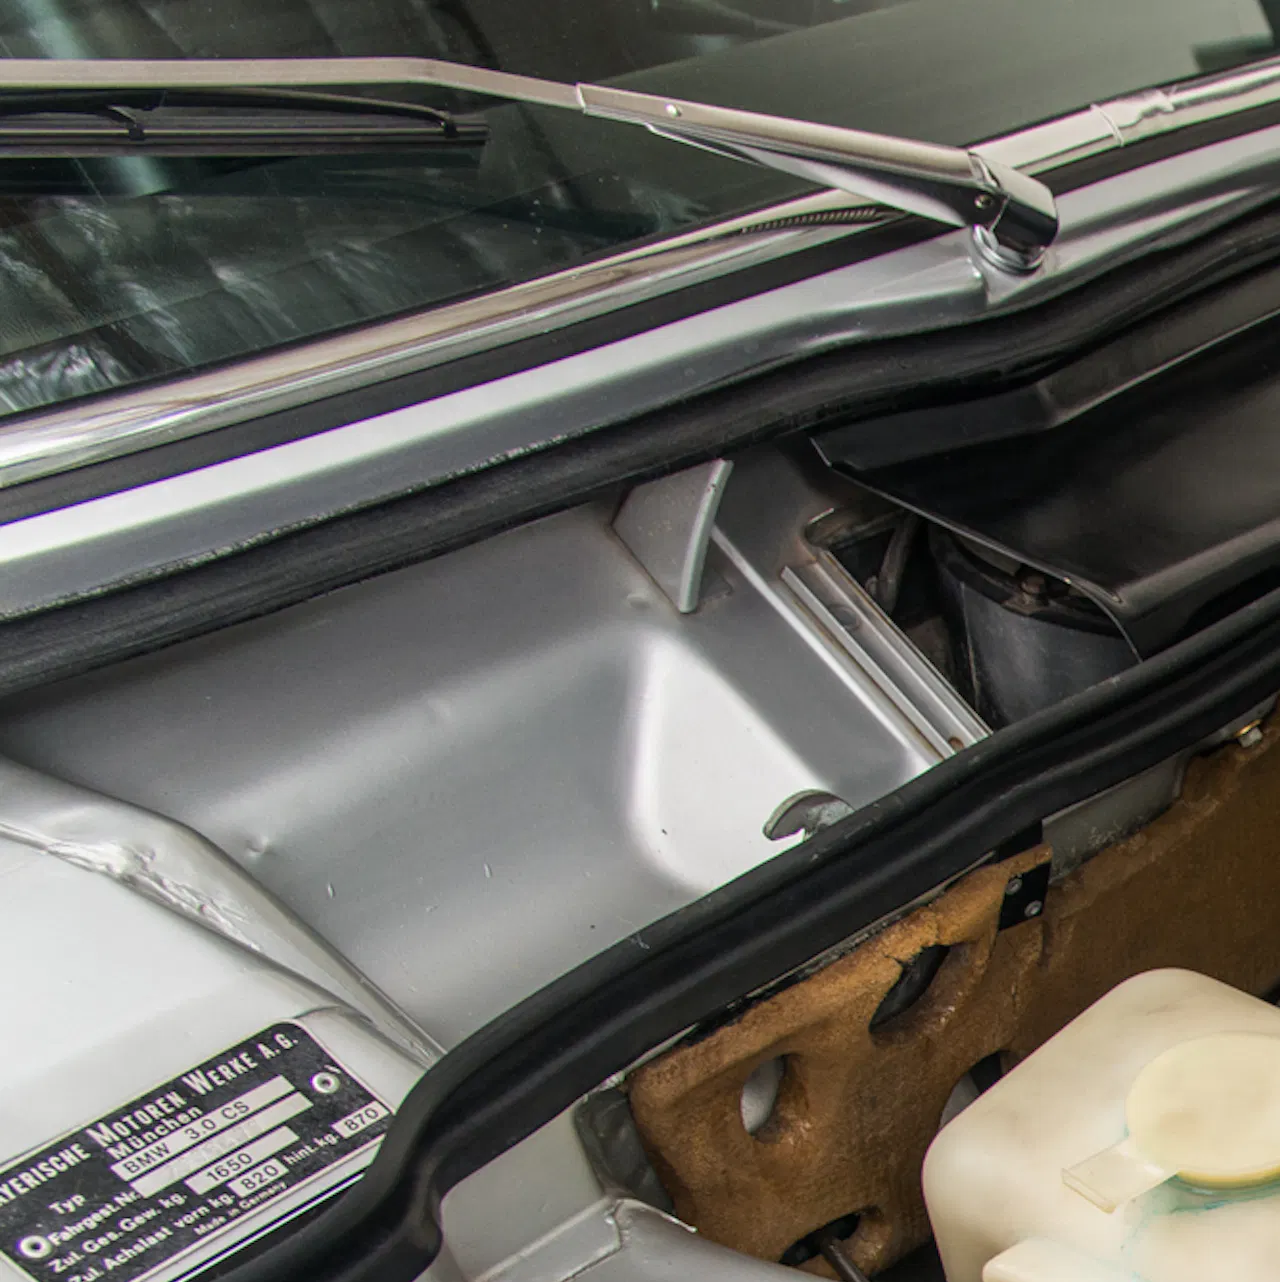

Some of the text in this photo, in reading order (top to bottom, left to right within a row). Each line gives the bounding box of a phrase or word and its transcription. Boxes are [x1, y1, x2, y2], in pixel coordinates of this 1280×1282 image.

[86, 1091, 187, 1148] MOTOREN
[182, 1052, 258, 1096] WERKE
[257, 1033, 299, 1060] A.G.
[106, 1105, 203, 1161] München
[48, 1100, 250, 1215] Typ BMW 3.0 CS
[49, 1251, 85, 1273] Zul.
[159, 1191, 188, 1210] kg.
[206, 1153, 253, 1182] 1650
[103, 1226, 173, 1271] Achslast
[174, 1206, 210, 1229] vorn
[208, 1192, 236, 1210] kg.
[241, 1165, 280, 1190] 820
[344, 1107, 379, 1132] 870
